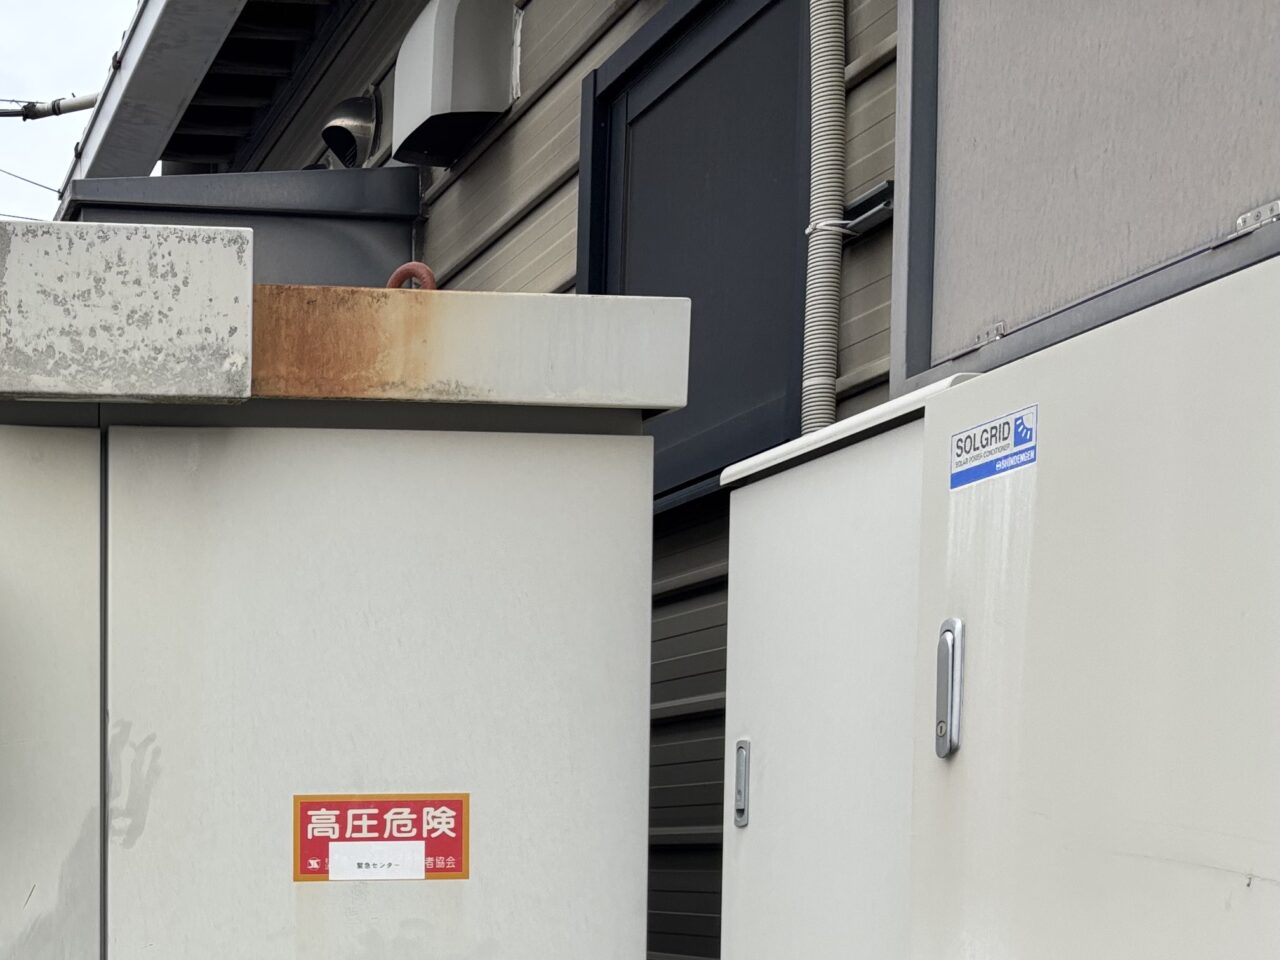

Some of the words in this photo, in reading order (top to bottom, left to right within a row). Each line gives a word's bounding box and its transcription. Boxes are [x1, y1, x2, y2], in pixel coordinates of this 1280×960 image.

[955, 421, 1011, 458] SOLGRID
[306, 805, 457, 840] 高圧危険
[356, 861, 401, 870] 緊急センター
